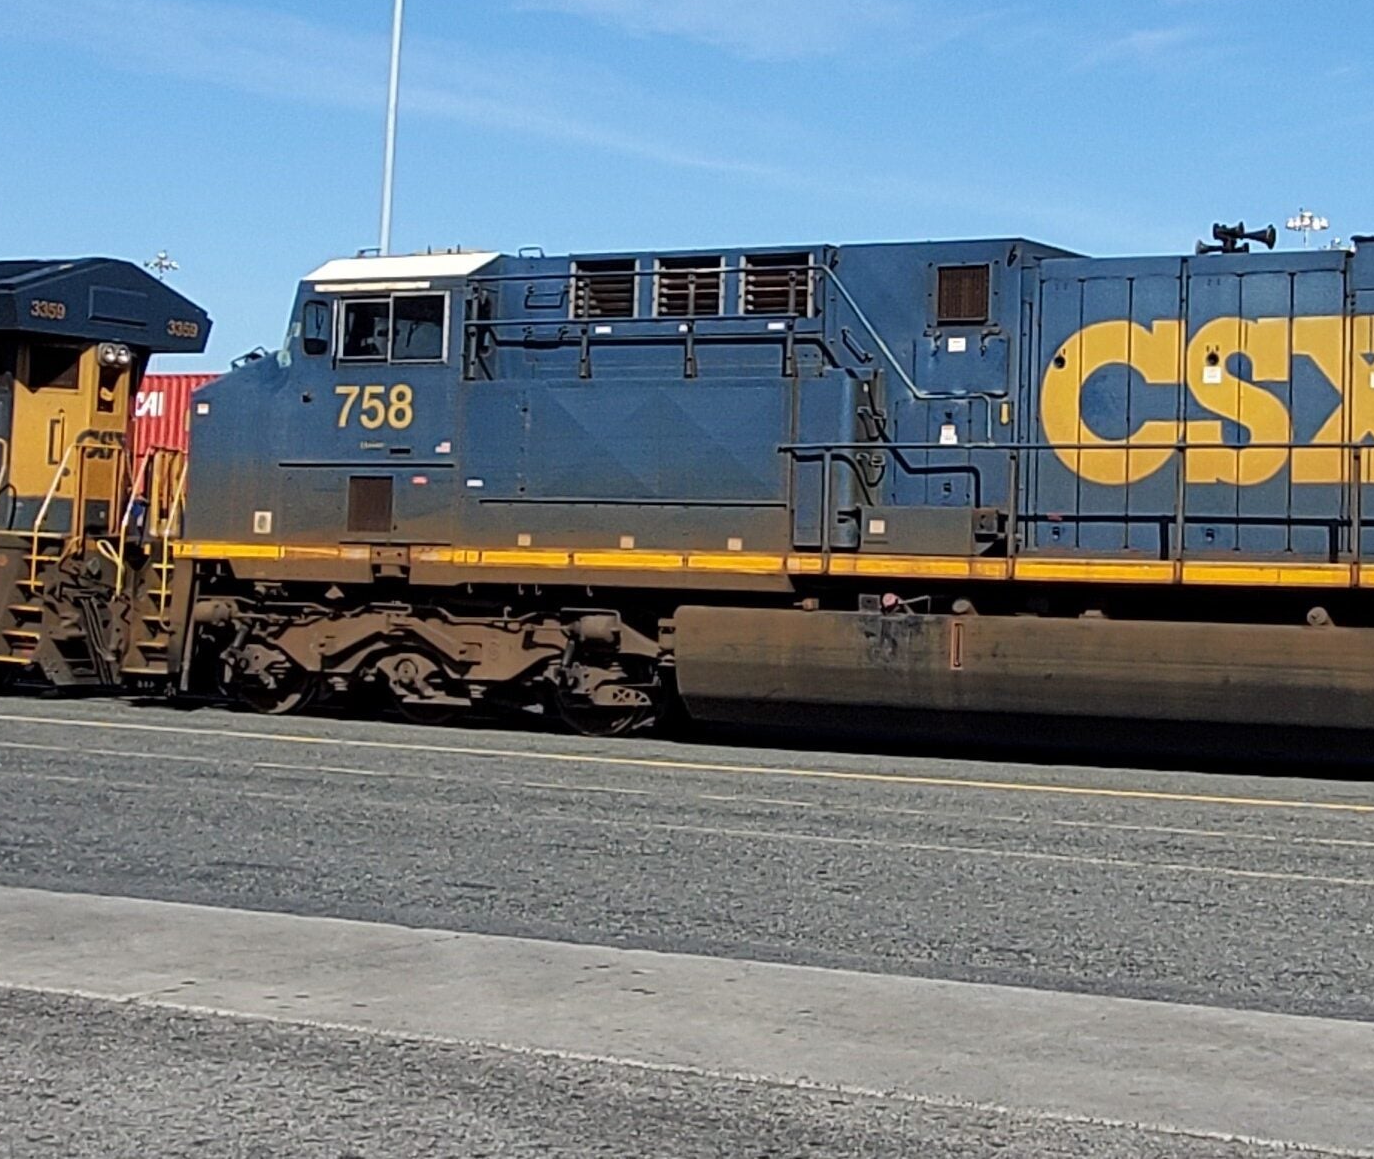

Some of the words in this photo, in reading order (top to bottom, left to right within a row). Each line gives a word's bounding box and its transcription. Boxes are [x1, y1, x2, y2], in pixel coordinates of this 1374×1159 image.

[31, 300, 66, 319] 3359
[135, 391, 164, 417] CAI
[335, 384, 413, 429] 758
